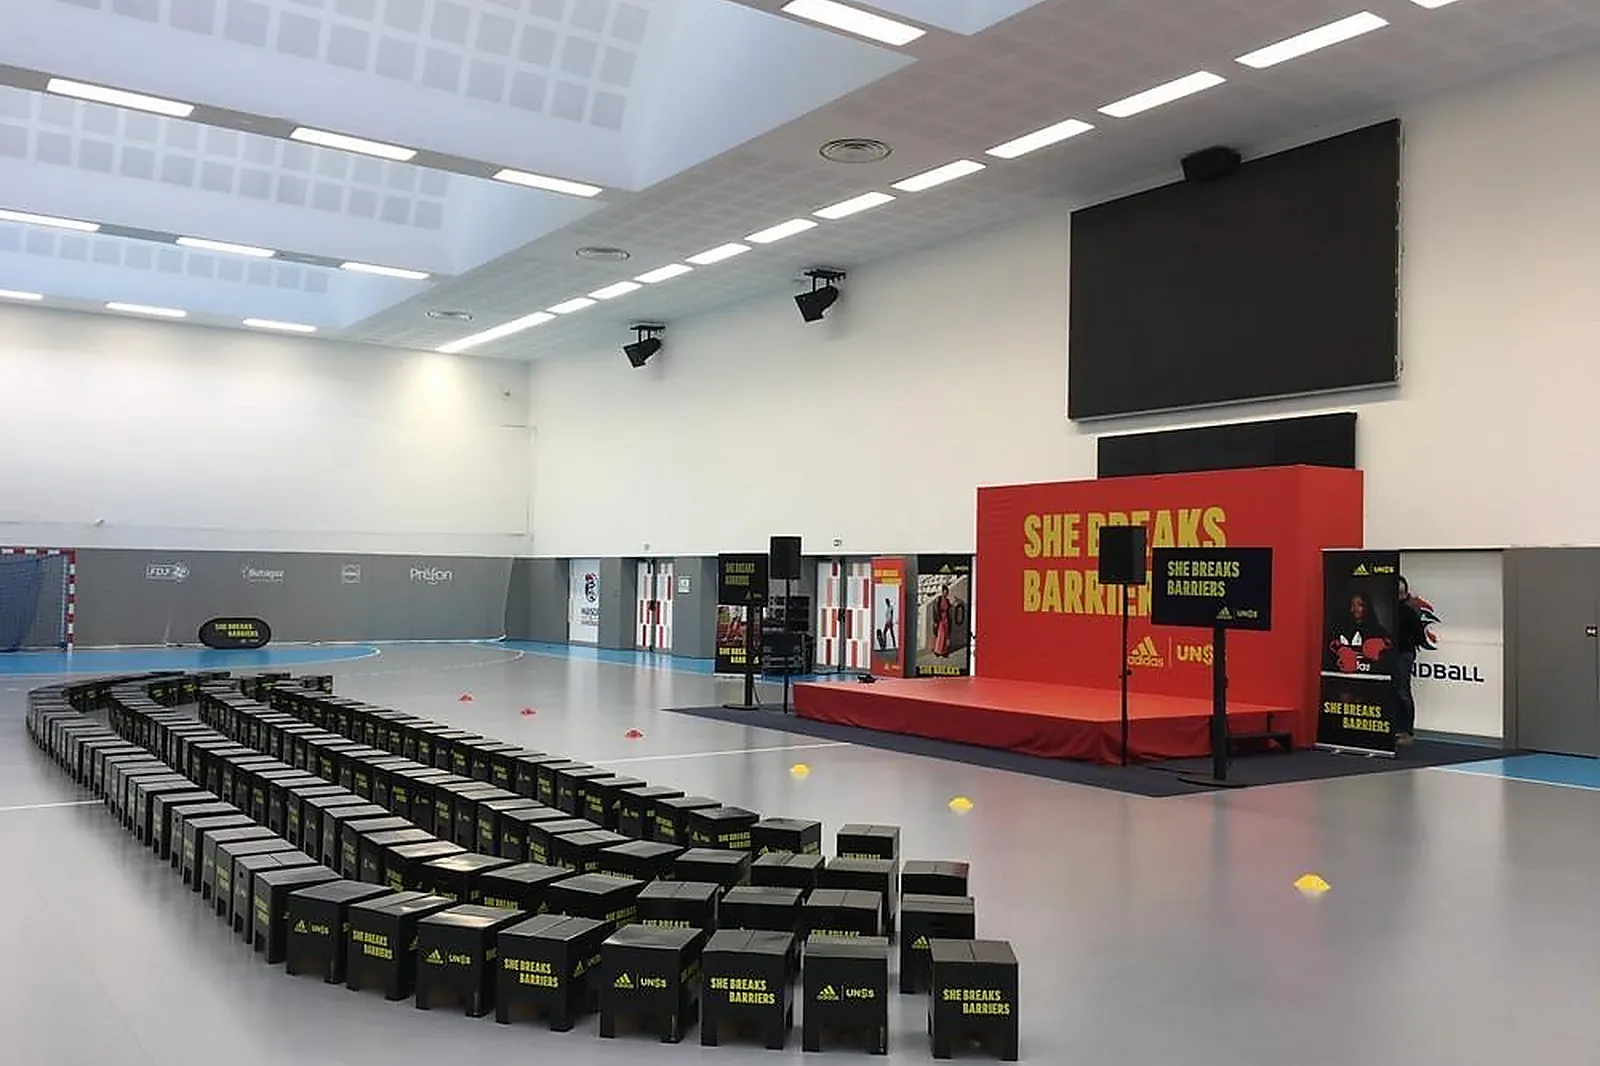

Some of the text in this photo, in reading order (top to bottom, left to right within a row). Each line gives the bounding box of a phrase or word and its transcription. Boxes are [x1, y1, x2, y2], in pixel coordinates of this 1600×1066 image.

[1023, 514, 1081, 558] SHE
[1167, 561, 1241, 578] SHE BREAKS
[1023, 569, 1152, 616] BARRI
[1167, 580, 1226, 597] BARRIERS
[1127, 654, 1164, 667] adidas
[1176, 645, 1214, 665] UNS
[1323, 701, 1382, 717] SHE BREAKS
[1343, 717, 1391, 733] BARRIERS
[504, 958, 551, 974] SHE BREAKS
[519, 973, 558, 988] BARRIERS
[711, 977, 767, 990] SHE BREAKS
[729, 991, 775, 1004] BARRIERS
[846, 988, 875, 999] UNSS
[943, 989, 1001, 1001] SHE BREAKS
[962, 1003, 1010, 1015] BARRIERS
